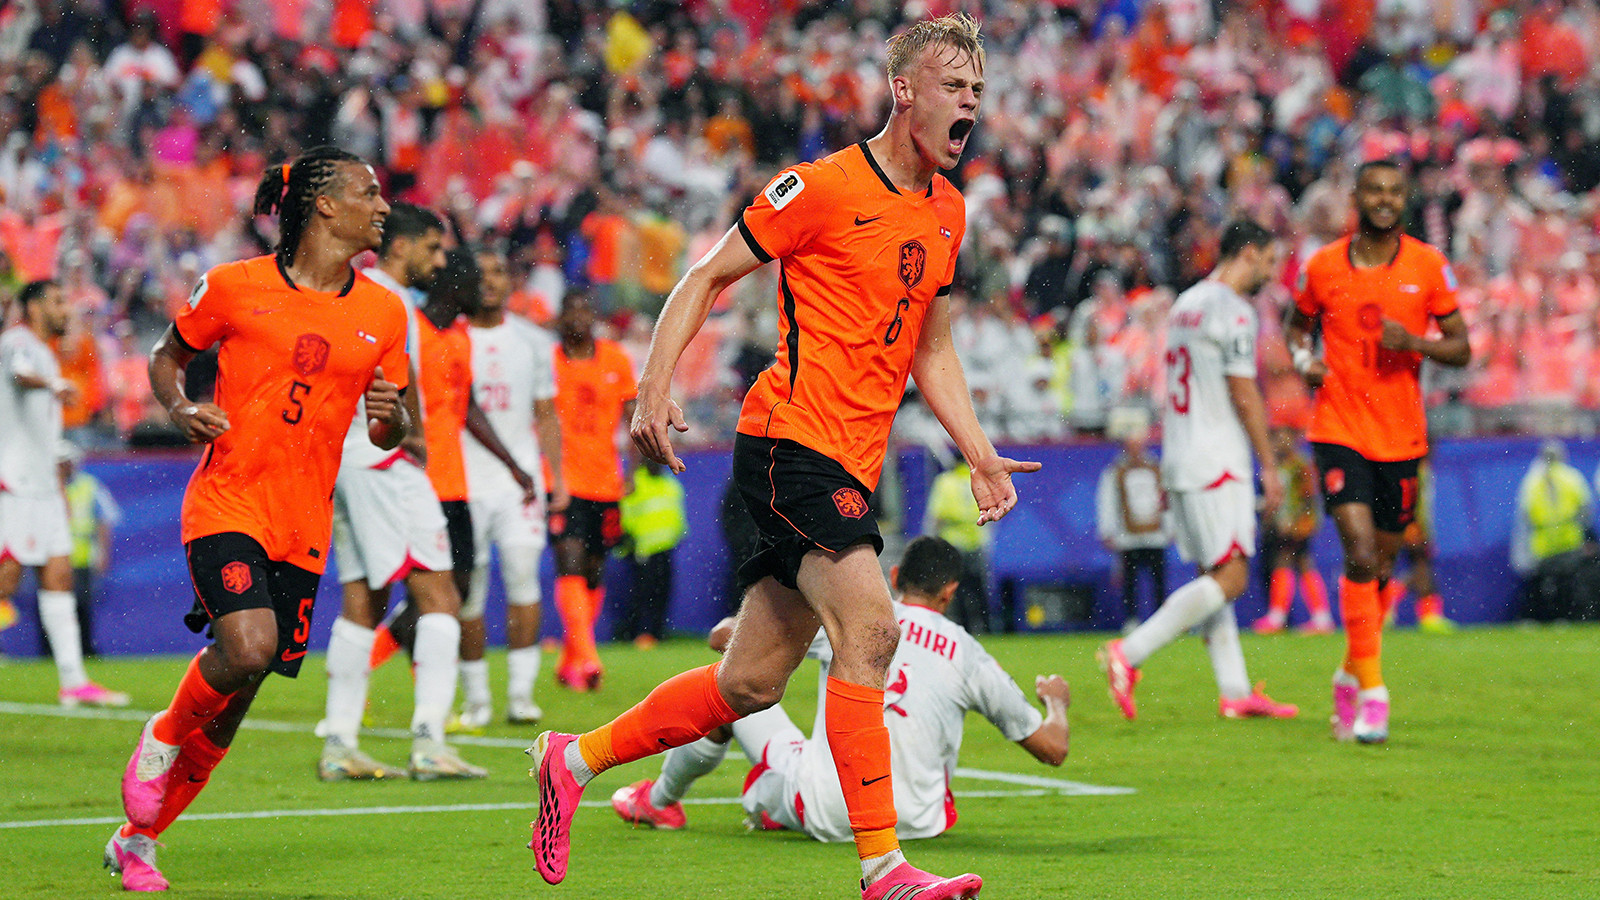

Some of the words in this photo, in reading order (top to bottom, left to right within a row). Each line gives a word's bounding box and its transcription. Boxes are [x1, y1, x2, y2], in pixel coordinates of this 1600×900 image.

[884, 297, 909, 346] 6
[282, 380, 312, 424] 5
[293, 598, 313, 643] 5
